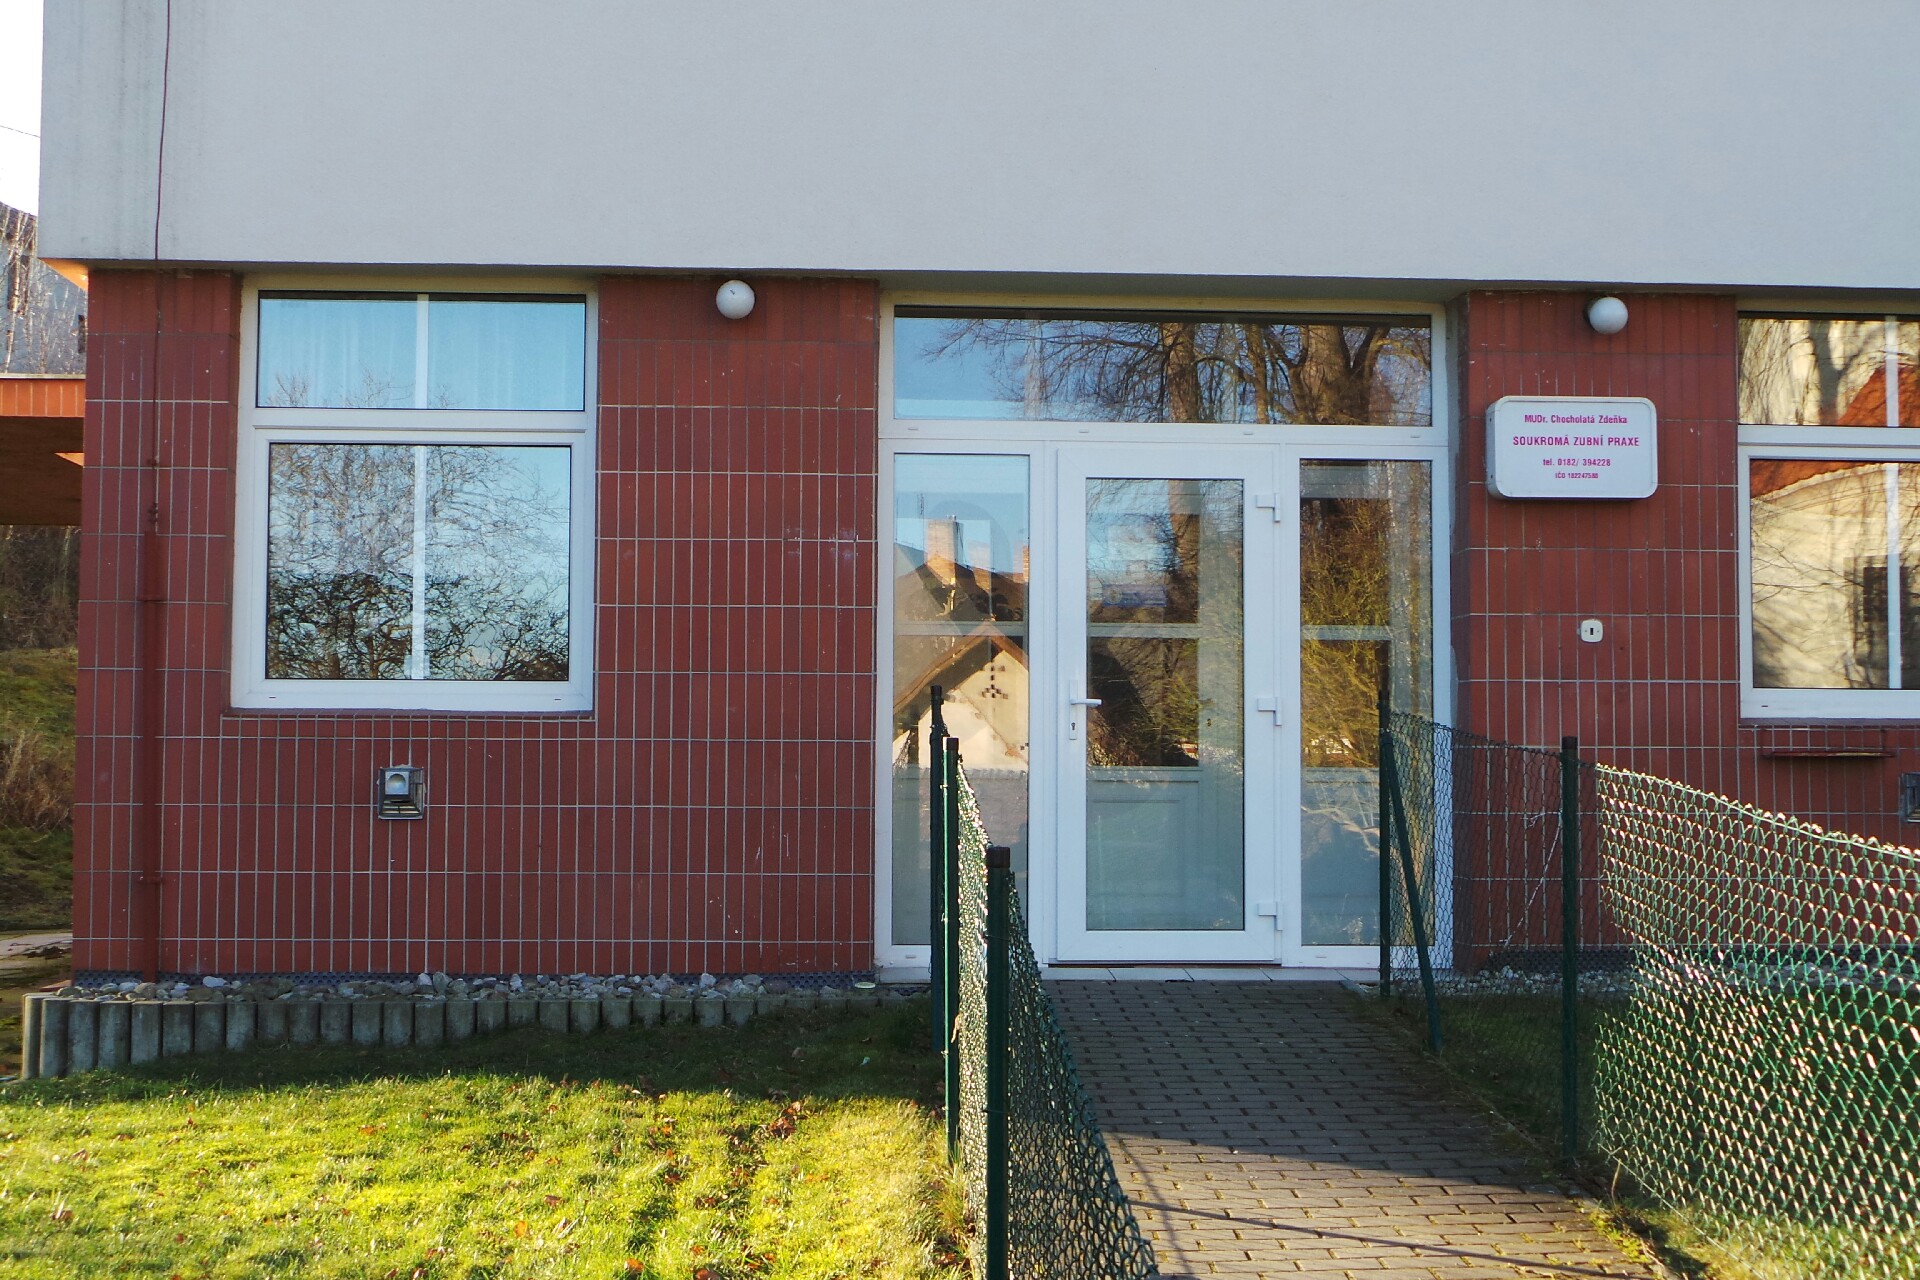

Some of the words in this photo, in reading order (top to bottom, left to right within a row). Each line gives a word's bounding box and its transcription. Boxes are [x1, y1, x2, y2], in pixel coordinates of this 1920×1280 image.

[1524, 414, 1548, 424] MUDr.
[1551, 414, 1595, 424] Chocholatá
[1598, 414, 1628, 424] Zdeňka
[1513, 434, 1570, 446] SOUKROMÁ
[1573, 434, 1604, 446] ZUBNÍ
[1607, 436, 1640, 446] PRAXE
[1543, 458, 1554, 467] tel.
[1557, 458, 1579, 467] 0182/
[1582, 458, 1611, 468] 394228
